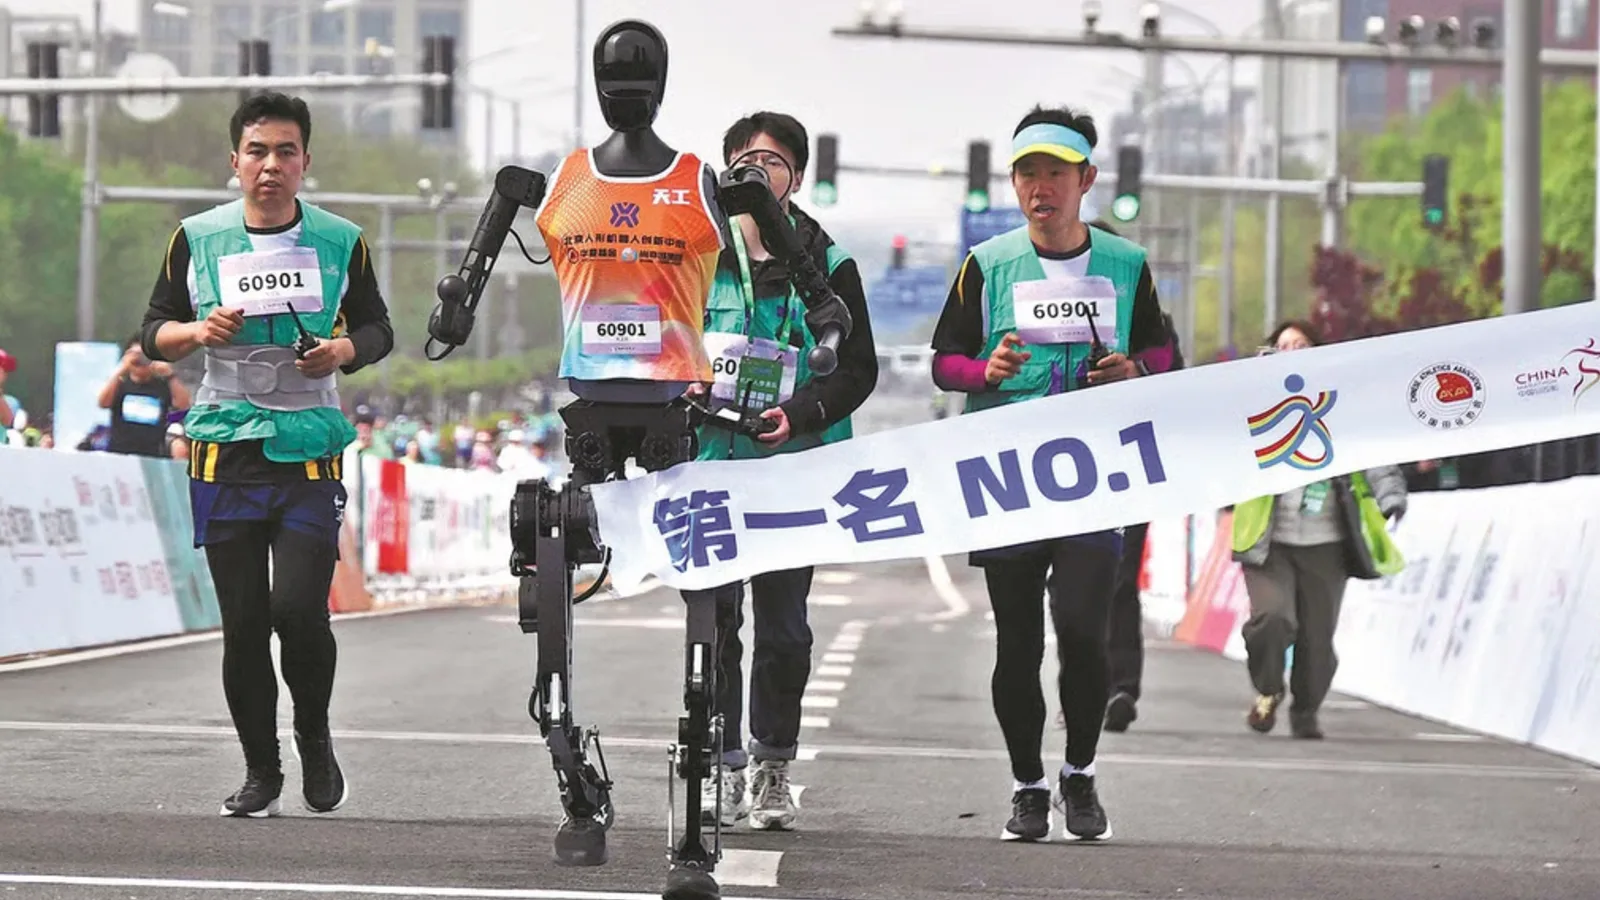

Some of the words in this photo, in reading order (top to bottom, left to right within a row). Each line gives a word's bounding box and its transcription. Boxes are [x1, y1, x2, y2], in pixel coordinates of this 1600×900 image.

[652, 188, 691, 205] 天工
[238, 271, 305, 292] 60901
[1033, 301, 1100, 319] 60901
[597, 323, 646, 337] 60901
[1515, 366, 1569, 385] CHINA
[652, 467, 924, 572] 第一名
[955, 420, 1167, 519] NO.1
